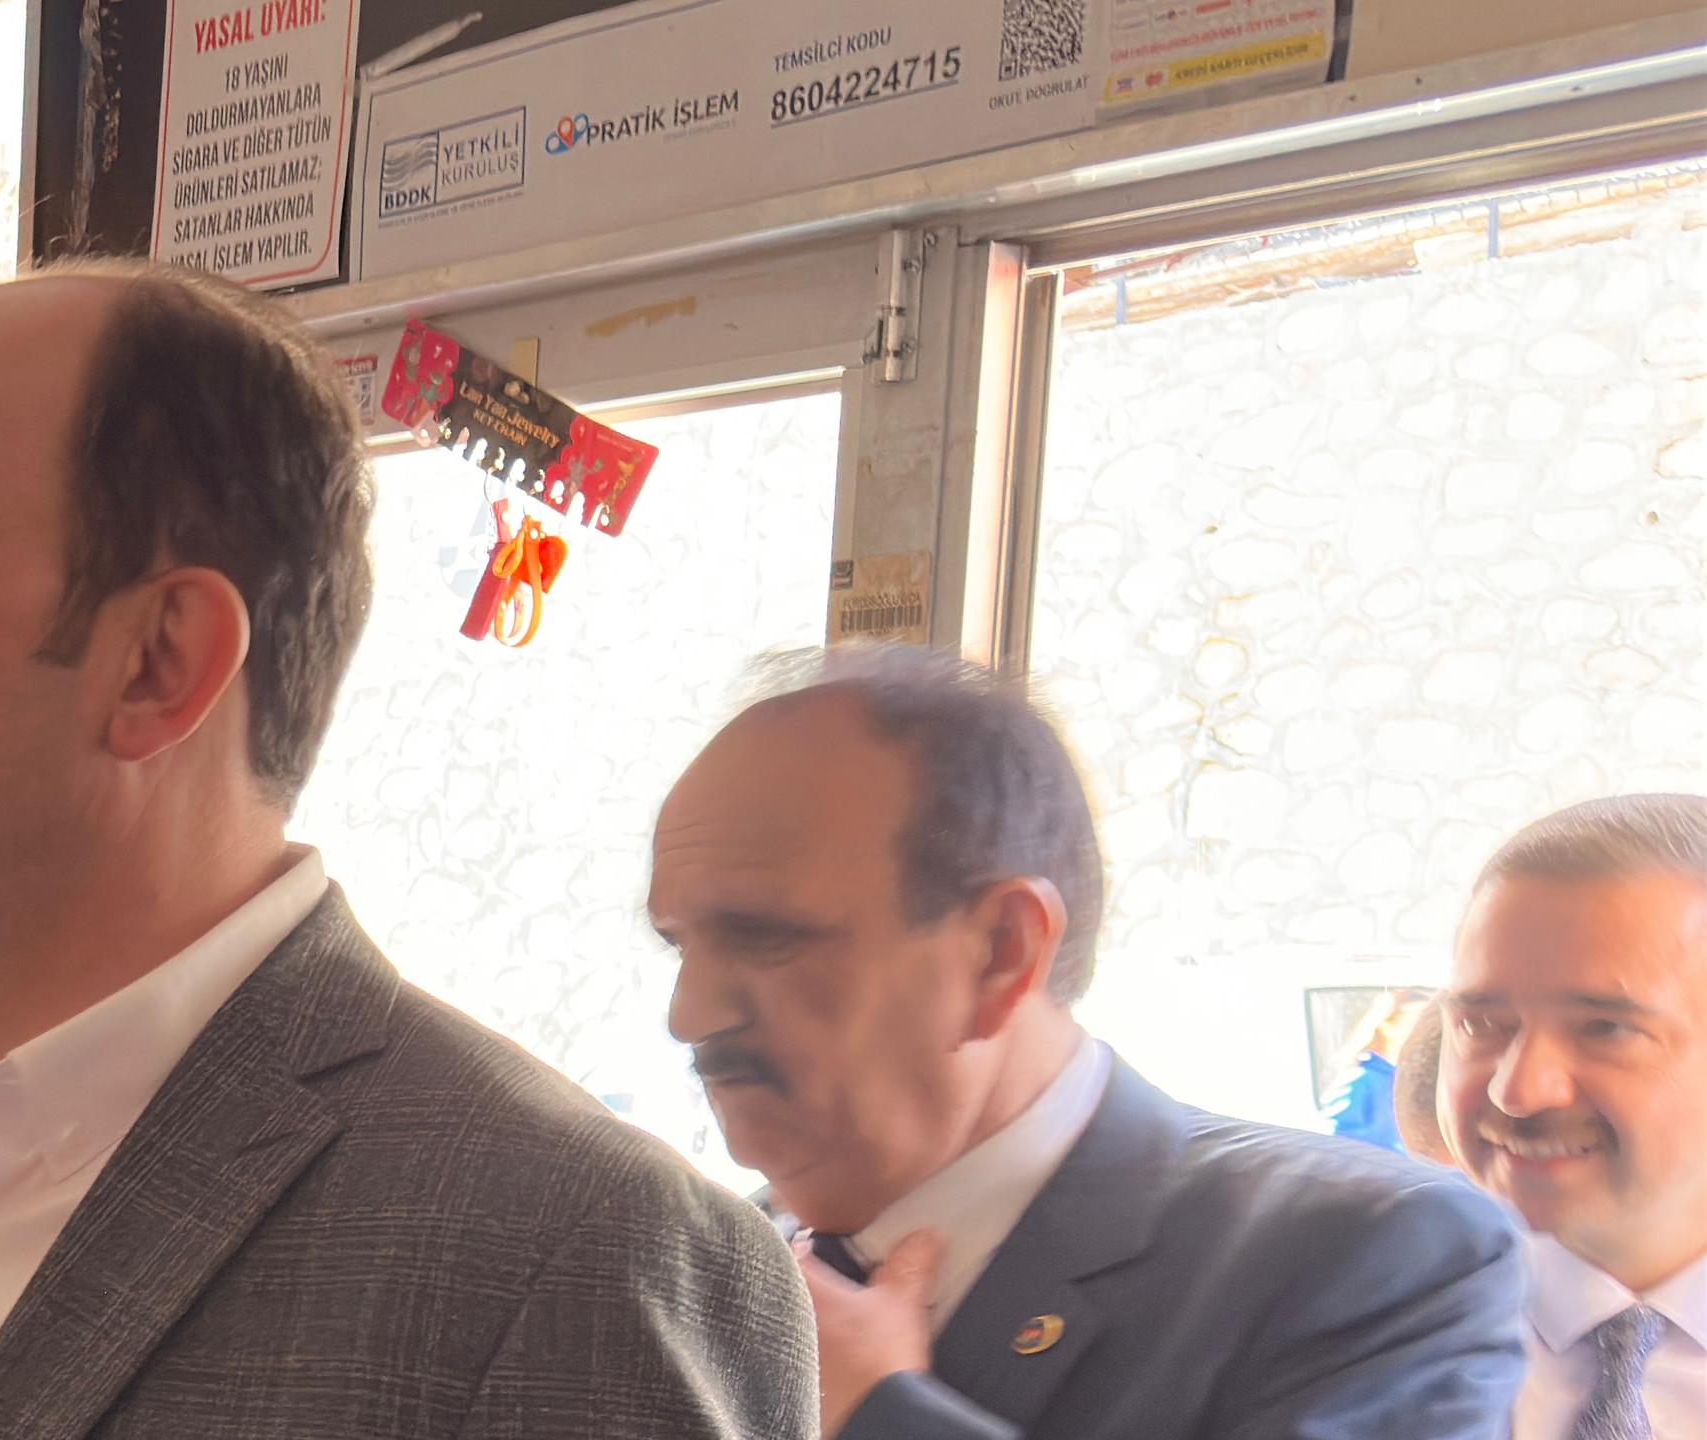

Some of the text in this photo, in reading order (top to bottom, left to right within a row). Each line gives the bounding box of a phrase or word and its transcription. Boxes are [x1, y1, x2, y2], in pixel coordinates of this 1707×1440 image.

[194, 6, 254, 55] YASAL
[774, 27, 893, 74] TEMSİLCİ KODU
[225, 52, 289, 94] 18 YAŞINI
[770, 46, 963, 123] 8604224715
[186, 82, 322, 138] DOLDURMAYANLARA
[586, 103, 667, 147] PRATİK
[673, 89, 741, 130] İŞLEM
[172, 115, 332, 176] SİGARA VE DİĞER TÜTÜN
[443, 121, 520, 163] YETKİLİ
[174, 154, 324, 211] ÜRÜNLERİ SATILAMAZ;
[441, 151, 521, 187] KURULUŞ
[174, 192, 315, 244] SATANLAR HAKKINDA
[384, 185, 432, 211] BDDK
[214, 242, 254, 272] İŞLEM
[257, 229, 313, 264] YAPILIR.
[506, 407, 562, 450] Jewelry
